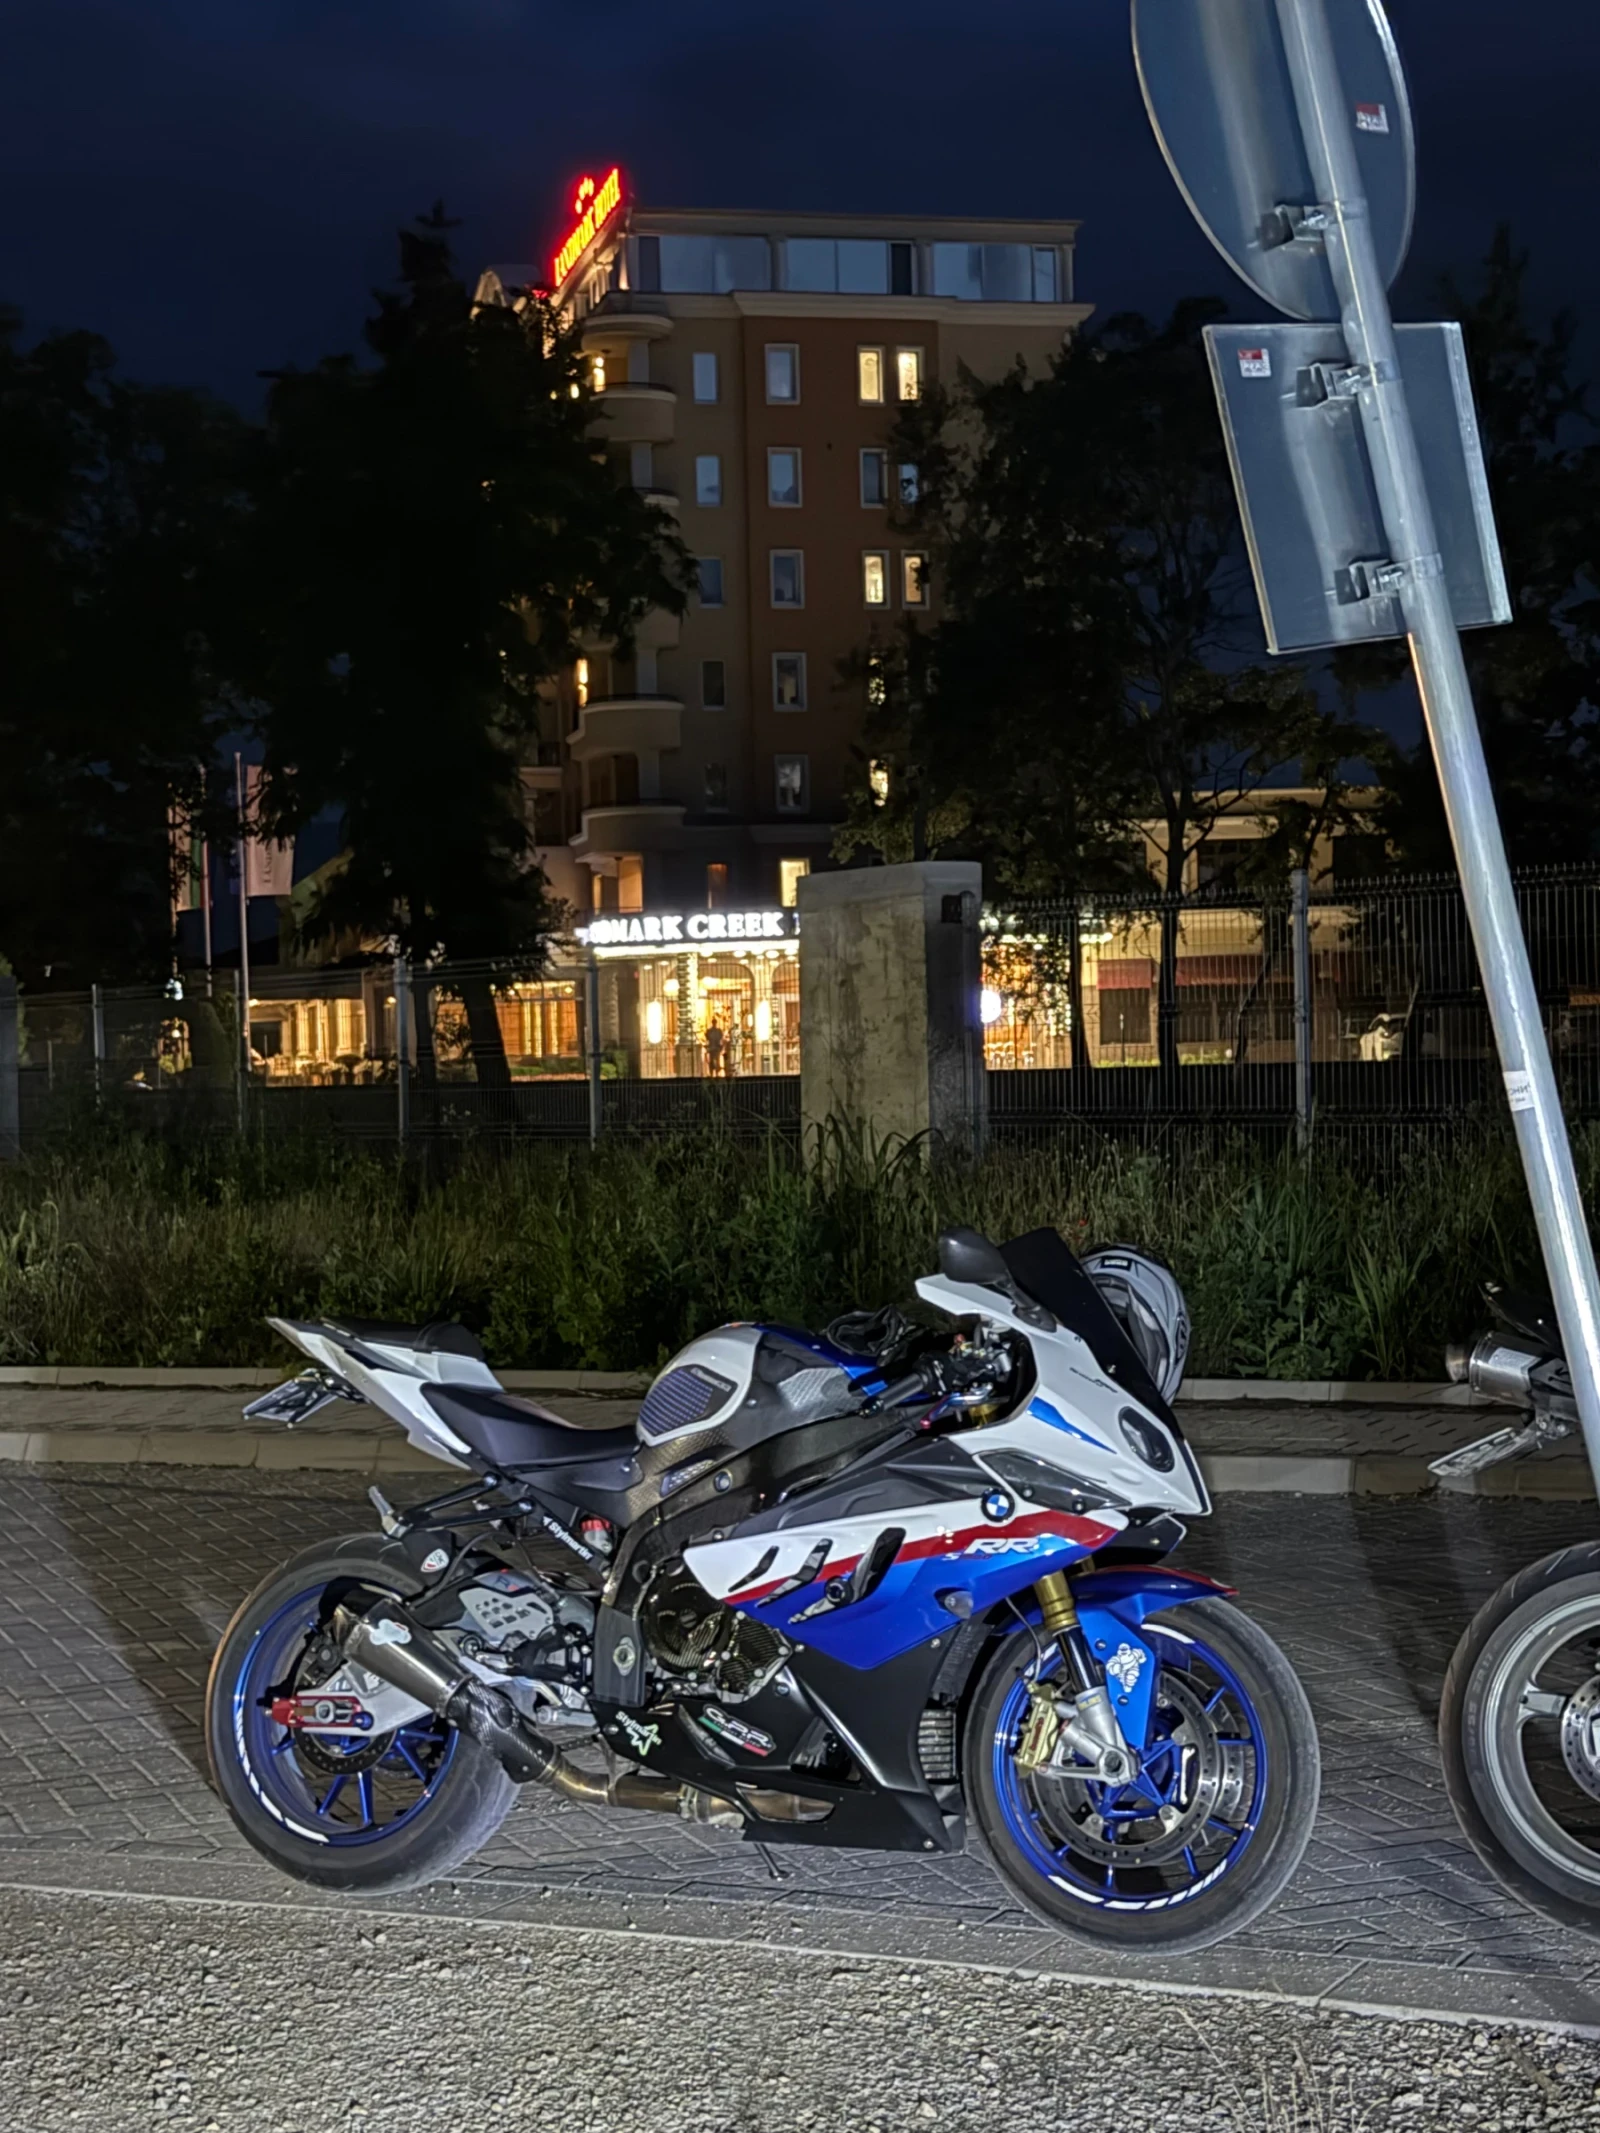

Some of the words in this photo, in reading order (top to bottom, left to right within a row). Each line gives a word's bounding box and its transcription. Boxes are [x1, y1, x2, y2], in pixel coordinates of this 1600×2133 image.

[594, 168, 620, 229] HOTEL
[686, 912, 785, 940] CREEK
[548, 1521, 593, 1560] Stylmartin
[964, 1538, 1038, 1555] RR
